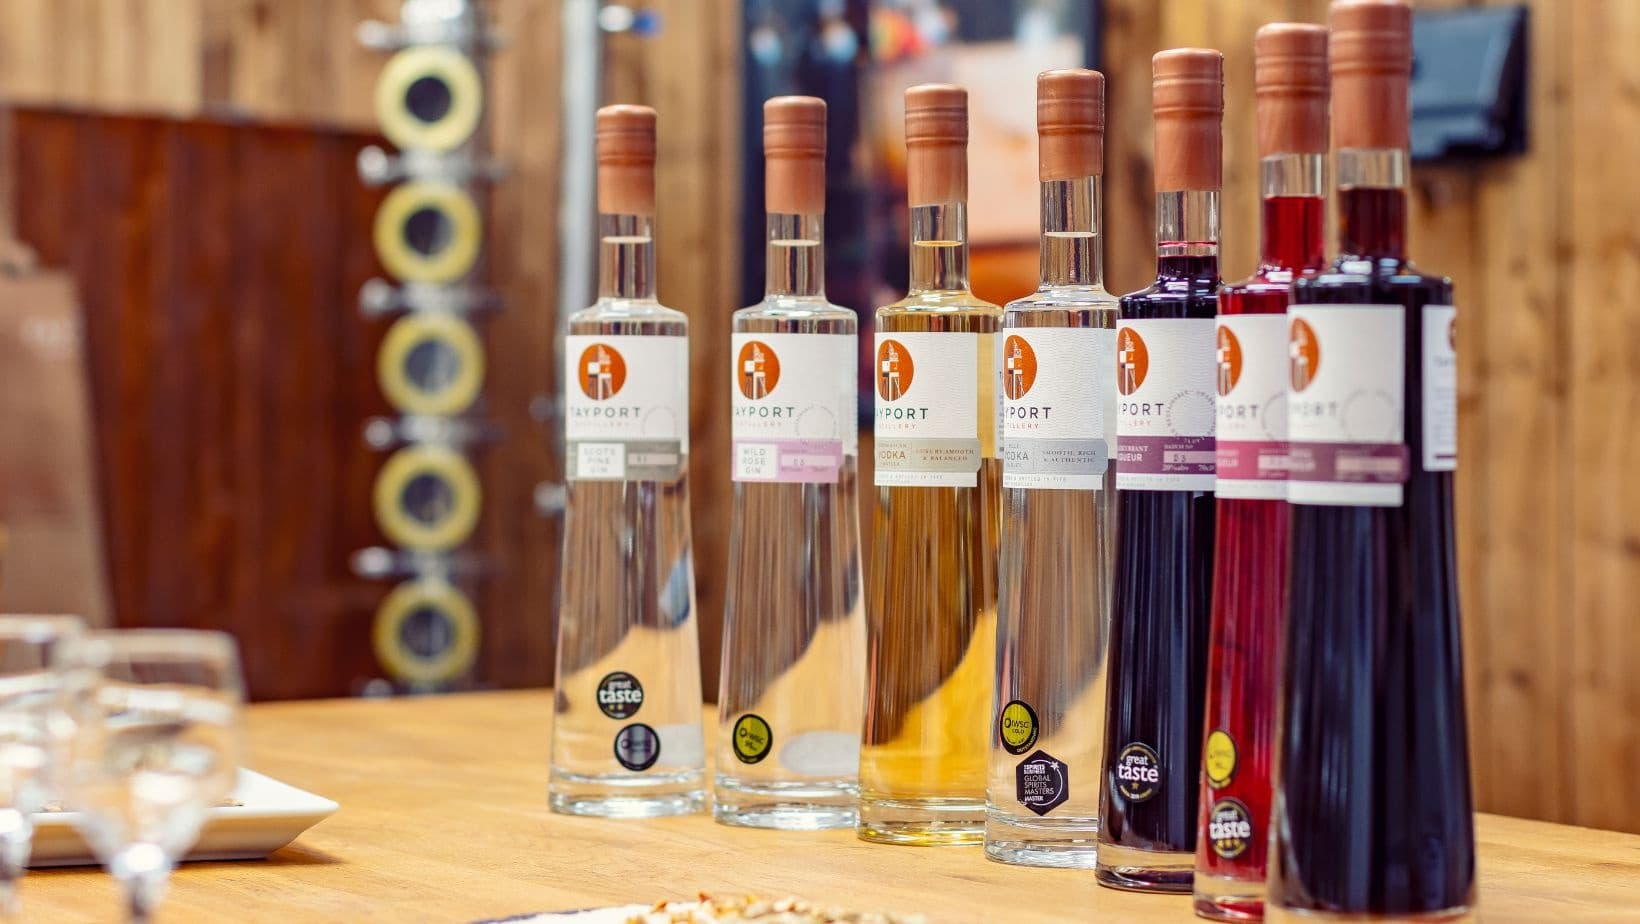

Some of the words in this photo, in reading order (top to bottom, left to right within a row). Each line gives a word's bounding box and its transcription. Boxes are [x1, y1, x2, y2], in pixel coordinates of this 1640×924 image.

[600, 689, 642, 703] taste
[1126, 755, 1149, 767] great
[1024, 775, 1052, 783] GLOBAL
[1118, 763, 1160, 783] taste
[1024, 788, 1055, 796] MASTERS
[1209, 821, 1251, 839] taste
